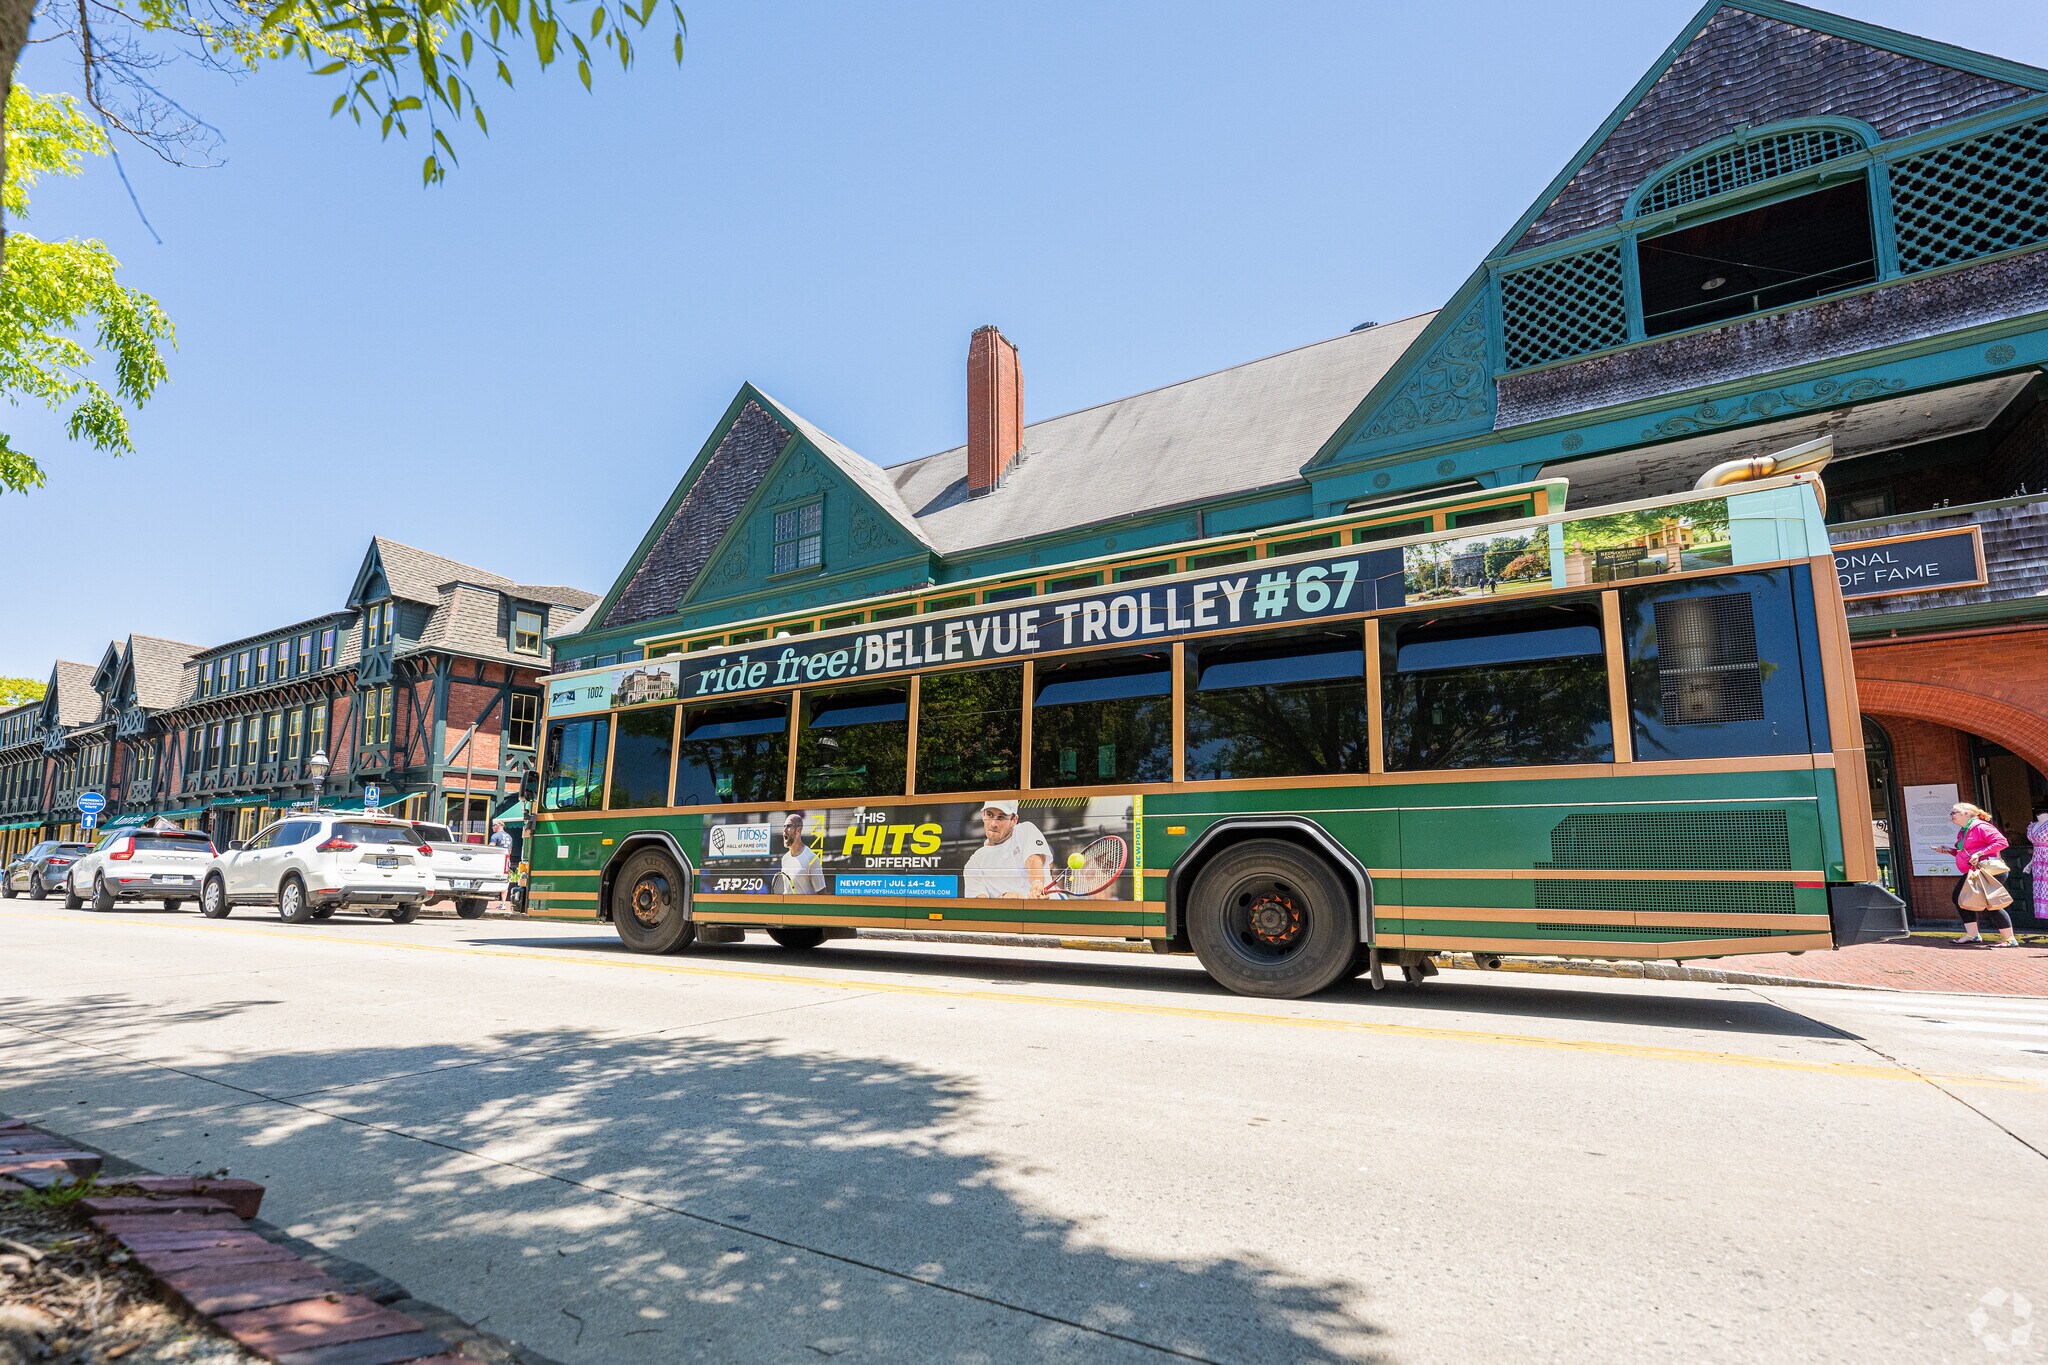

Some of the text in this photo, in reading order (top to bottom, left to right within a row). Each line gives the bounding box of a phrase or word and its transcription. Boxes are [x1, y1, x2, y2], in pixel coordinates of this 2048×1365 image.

[1838, 563, 1940, 587] OF FAME
[696, 560, 1359, 695] ride free! BELLEVUE TROLLEY #67
[587, 686, 604, 699] 1002
[854, 812, 886, 823] THIS
[738, 827, 768, 842] Infosys
[842, 823, 943, 855] HITS
[865, 856, 942, 868] DIFFERENT
